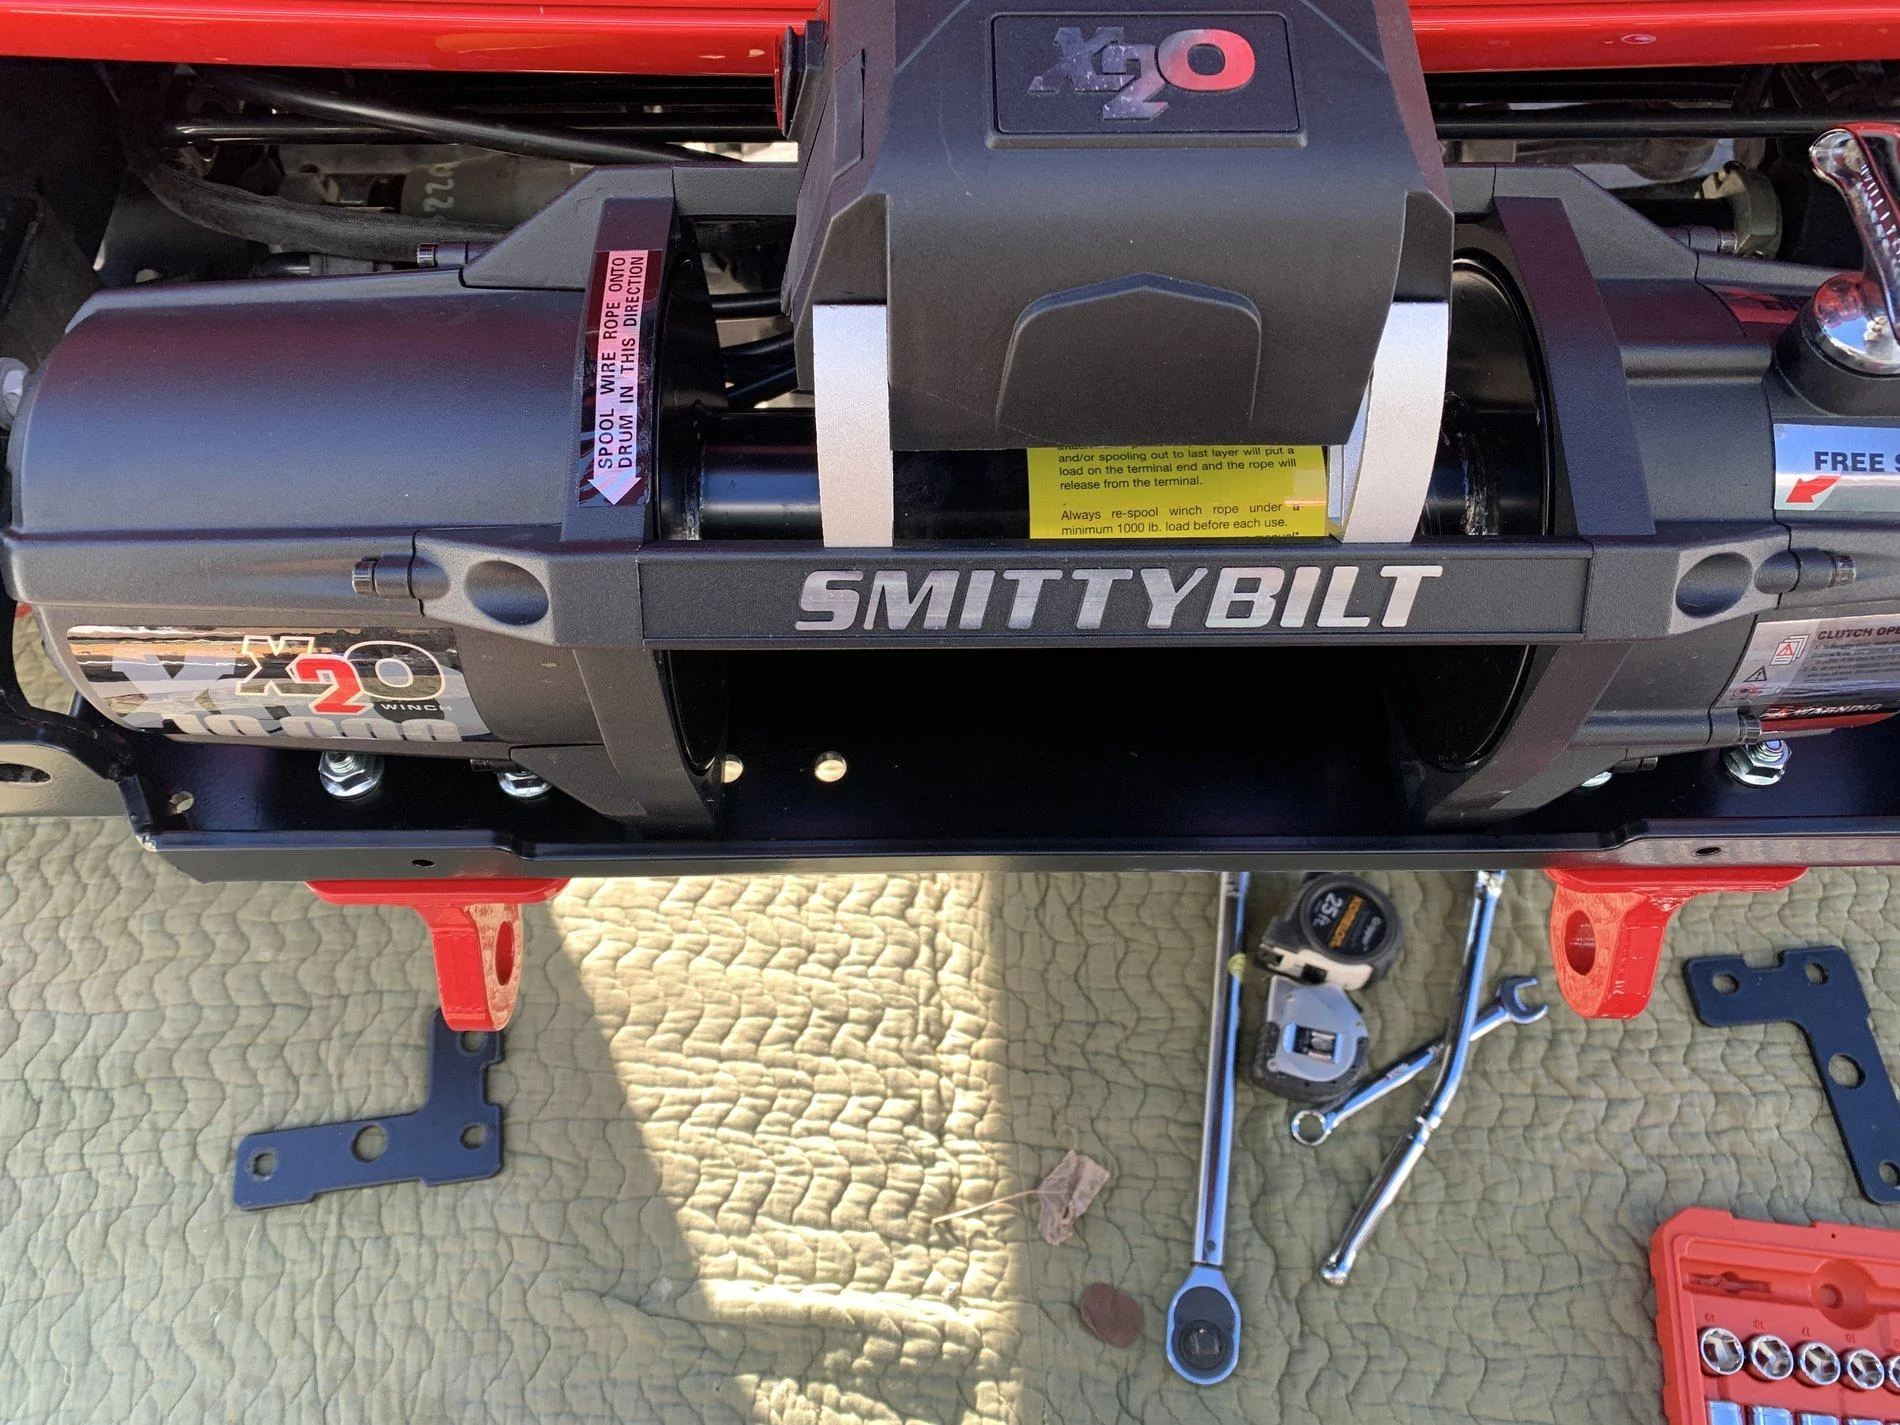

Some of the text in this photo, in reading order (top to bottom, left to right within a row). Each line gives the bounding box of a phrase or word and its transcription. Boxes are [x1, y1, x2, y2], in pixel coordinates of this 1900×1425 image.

[598, 257, 626, 469] SPOOL WIRE ROPE ONTO
[618, 256, 644, 468] DRUM IN THIS DIRECTION
[1058, 447, 1295, 463] and/or spooling out to last layer will put a
[1814, 451, 1885, 472] FREE
[1060, 458, 1296, 476] load on the terminal end and the rope will
[1060, 476, 1202, 490] release from the terminal.
[1061, 502, 1300, 522] Always re-spool winch rope under a
[1062, 518, 1288, 536] minimum 1000 lb. load before each use.
[795, 565, 1444, 631] SMITTYBILT
[1817, 628, 1873, 640] CLUTCH
[380, 703, 453, 712] WINCH
[1321, 892, 1344, 919] 25
